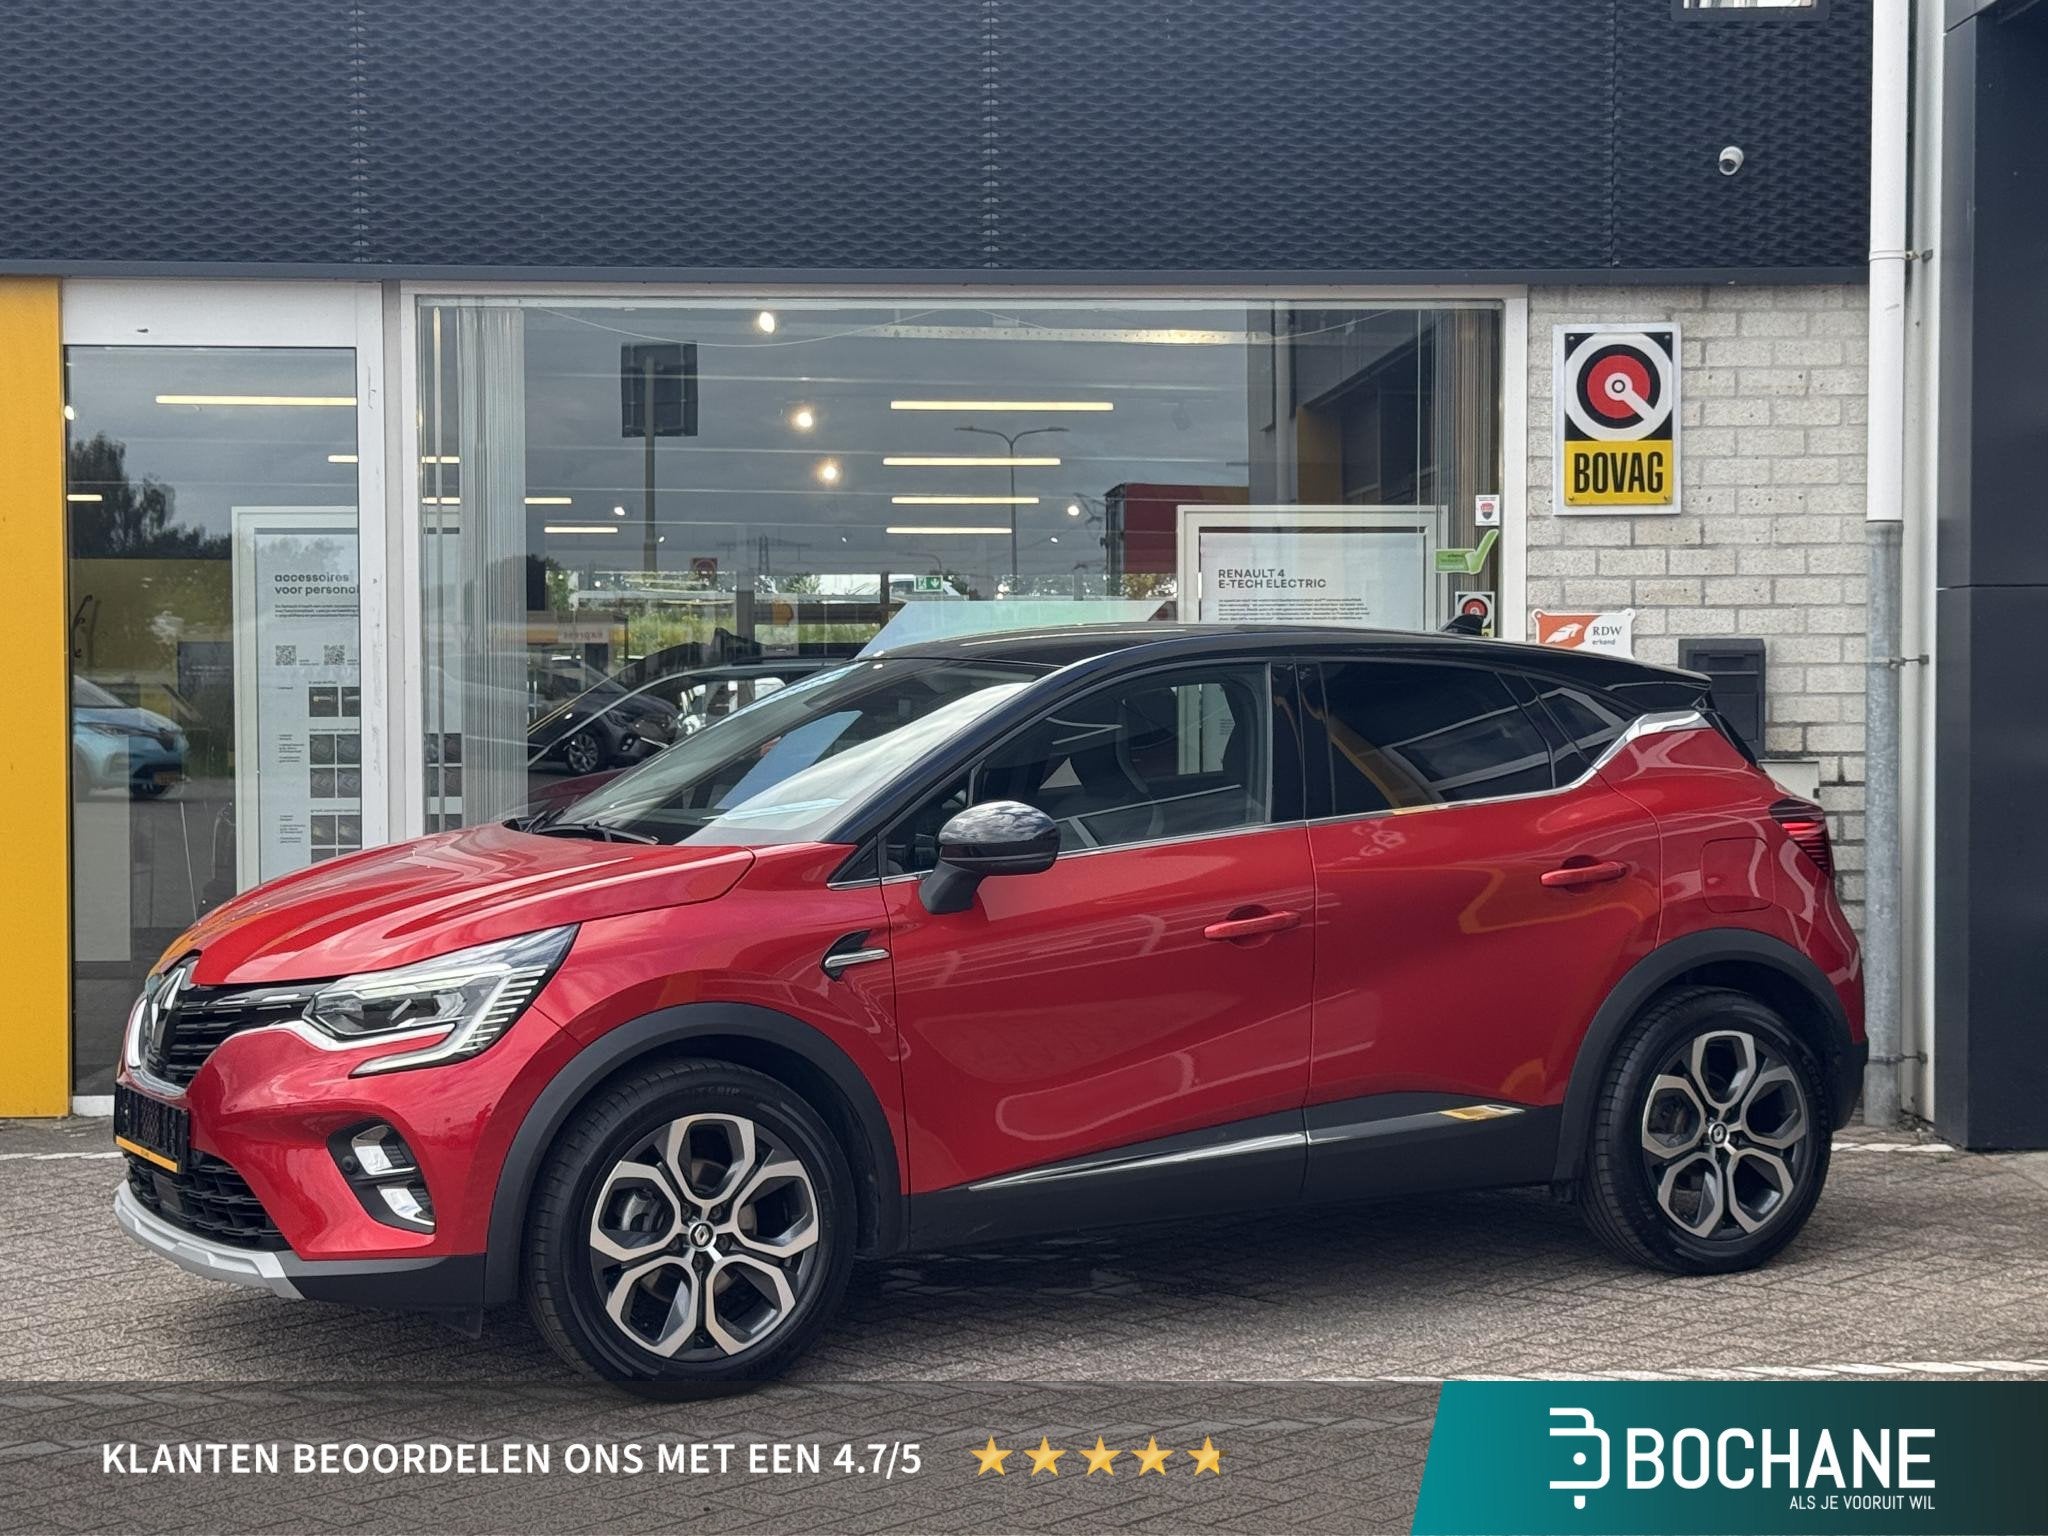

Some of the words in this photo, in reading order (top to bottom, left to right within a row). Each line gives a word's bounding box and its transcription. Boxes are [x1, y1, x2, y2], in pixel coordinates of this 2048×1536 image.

[1574, 451, 1663, 493] BOVAG
[275, 573, 349, 582] accessoires
[1218, 569, 1275, 578] RENAULT
[1277, 569, 1285, 578] 4
[1218, 579, 1263, 589] E-TECH
[1266, 579, 1327, 589] ELECTRIC
[275, 586, 303, 594] voor
[1593, 626, 1622, 636] RDW
